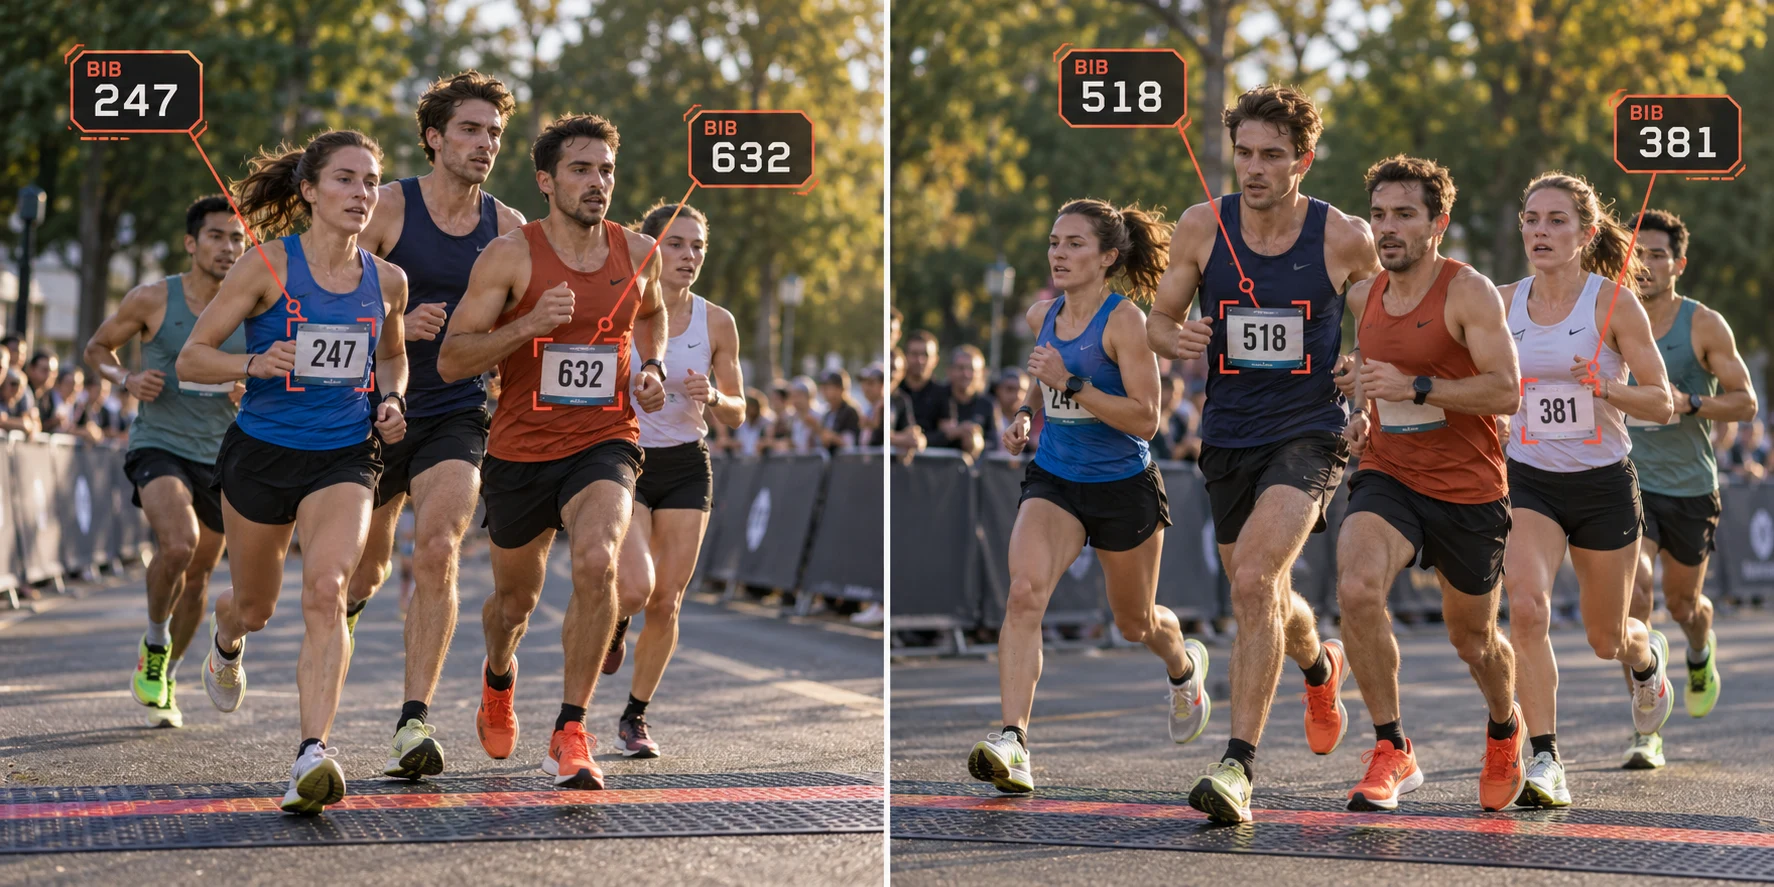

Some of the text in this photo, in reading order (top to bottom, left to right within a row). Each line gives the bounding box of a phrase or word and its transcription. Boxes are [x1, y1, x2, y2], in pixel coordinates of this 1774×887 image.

[1243, 323, 1286, 351] 518
[311, 339, 357, 368] 247
[558, 359, 604, 388] 632
[1540, 397, 1577, 424] 381
